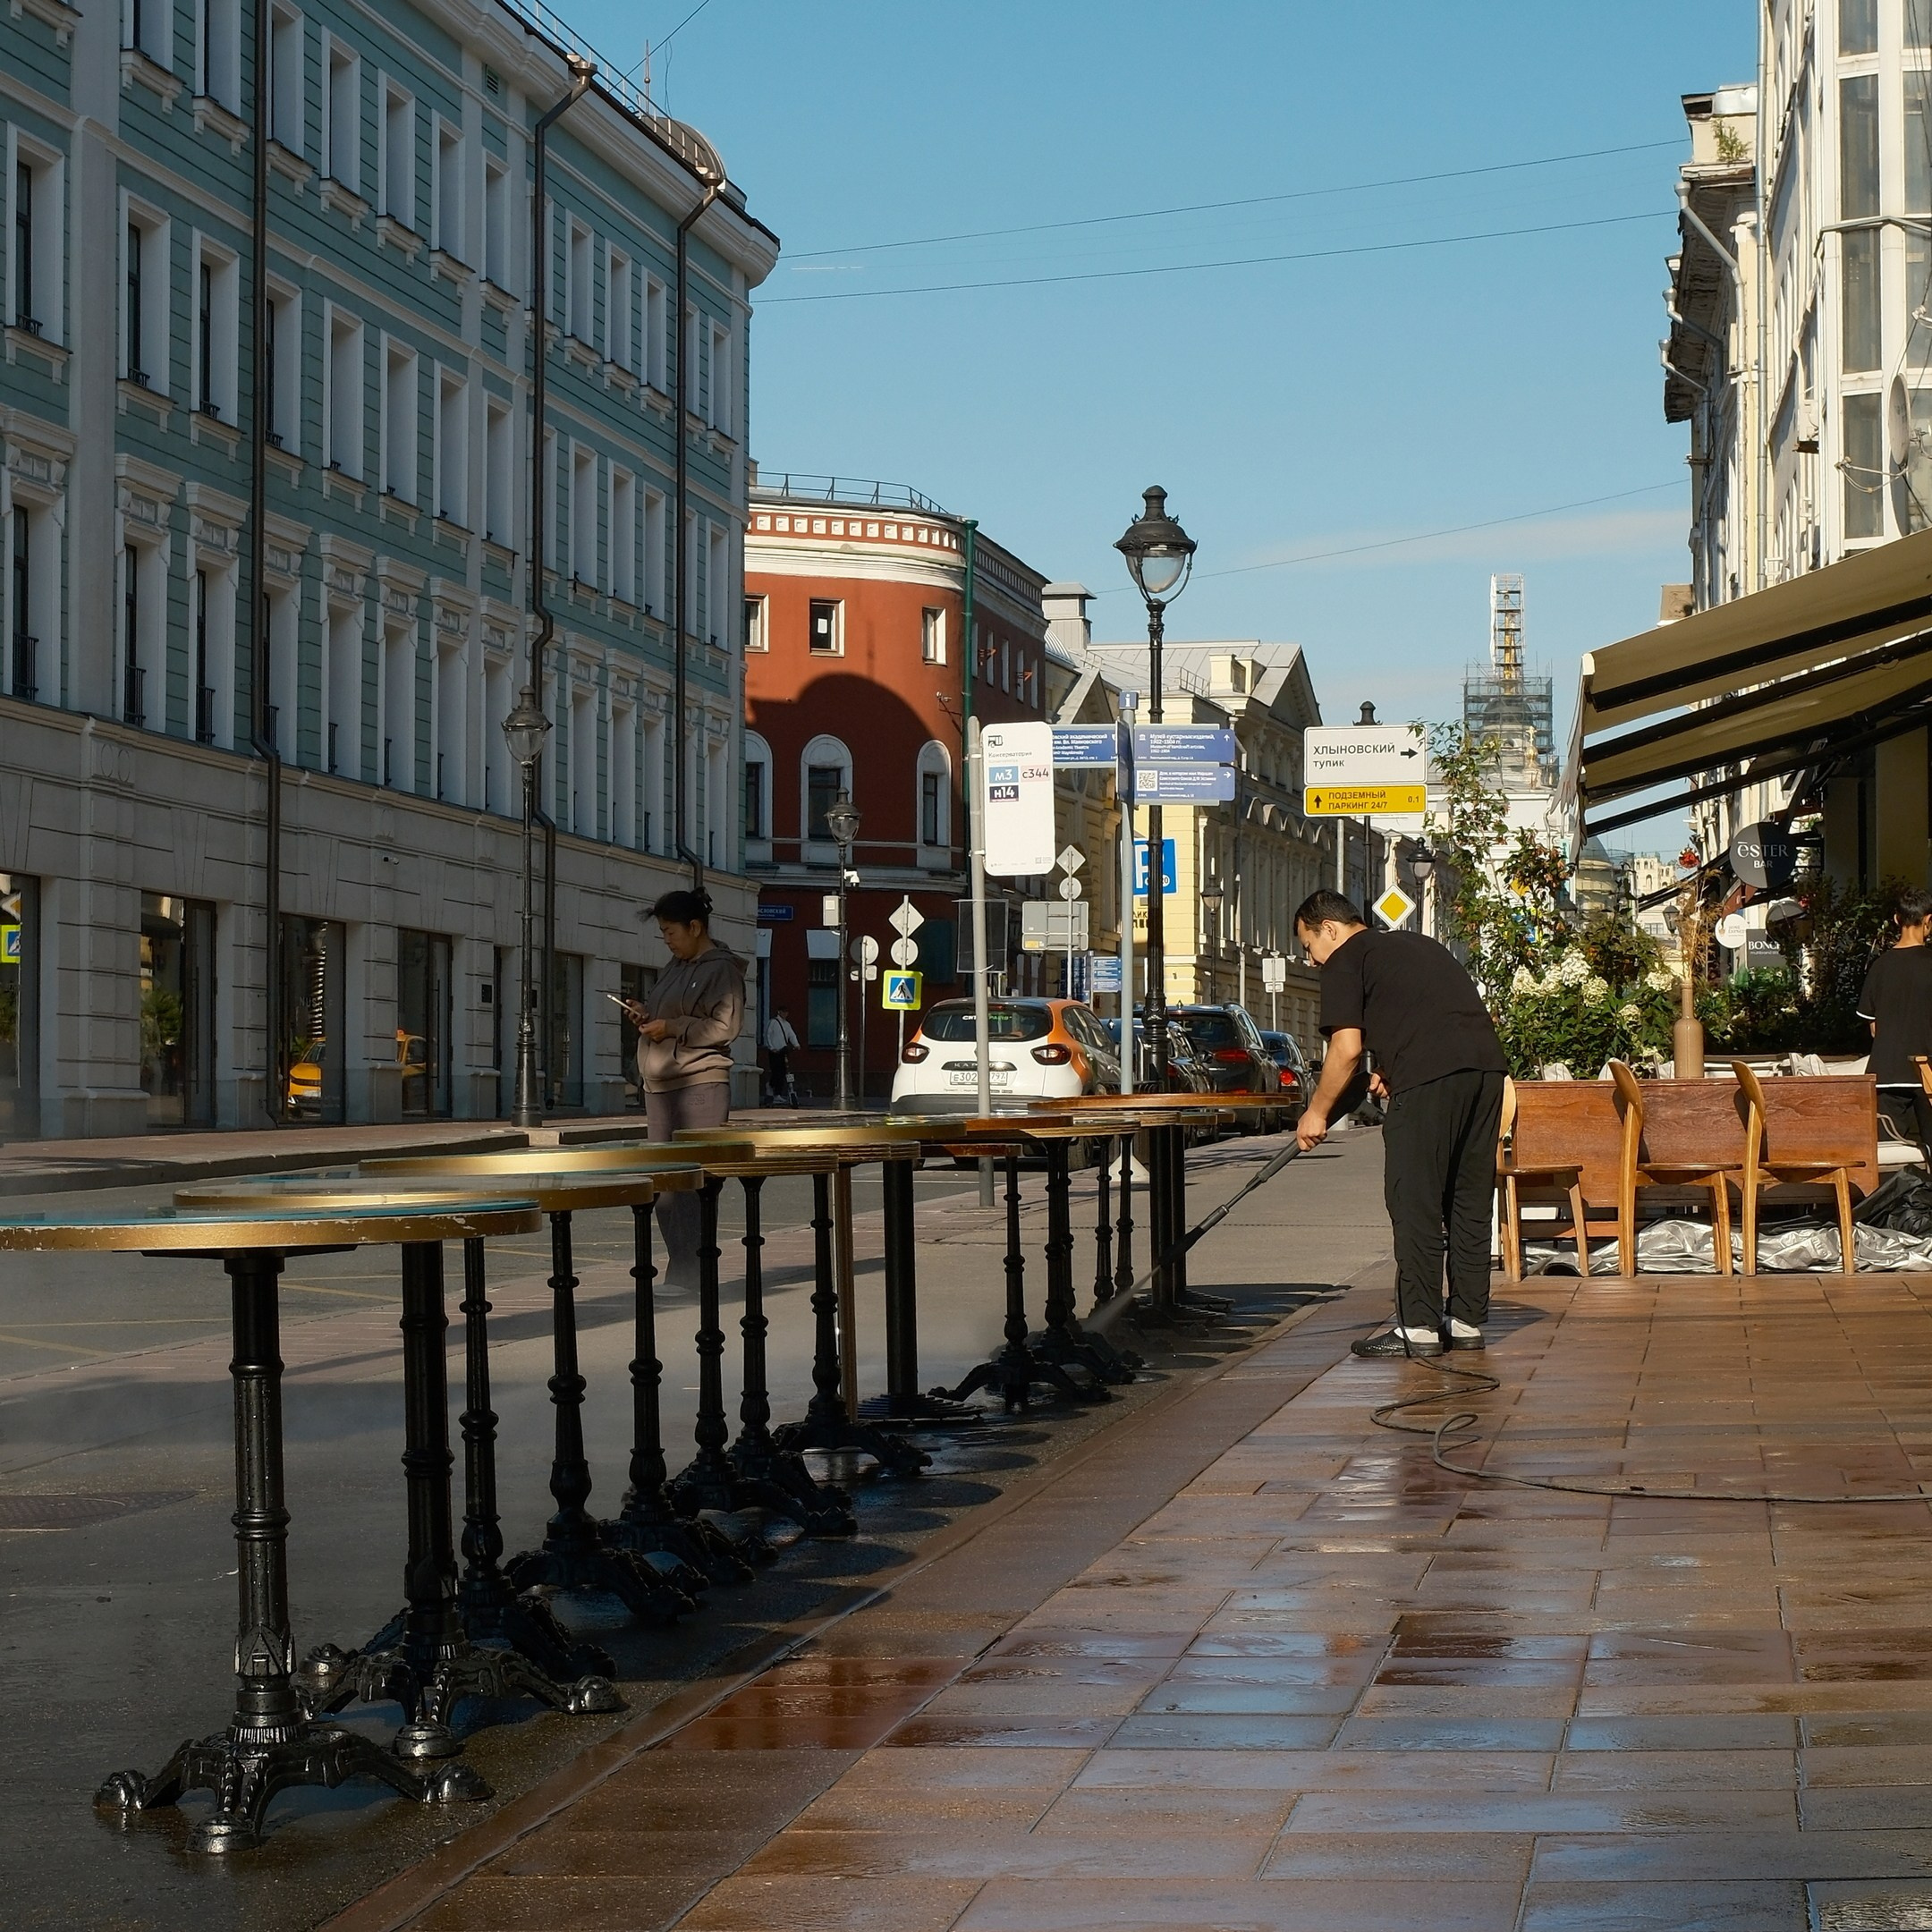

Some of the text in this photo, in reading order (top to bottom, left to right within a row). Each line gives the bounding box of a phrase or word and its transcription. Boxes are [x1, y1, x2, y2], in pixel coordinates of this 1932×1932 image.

[1313, 742, 1395, 755] ХЛЫНОВСКИЙ
[1313, 759, 1344, 769] тупик
[1329, 790, 1419, 803] ПОДЗЕМНЫЙ 0.1
[1328, 801, 1388, 810] ПАРКИНГ 24/7
[1753, 860, 1773, 869] BAR
